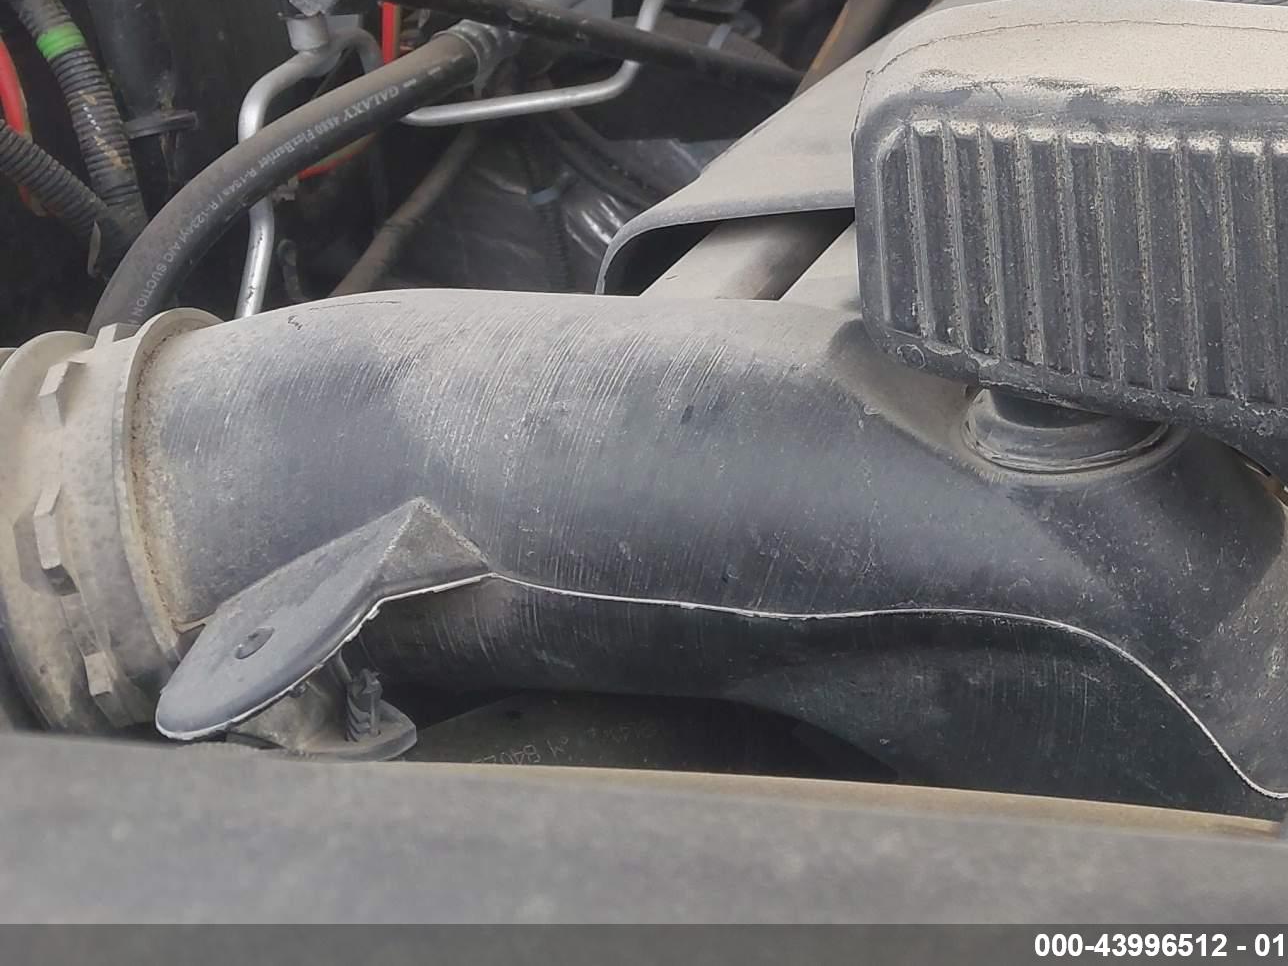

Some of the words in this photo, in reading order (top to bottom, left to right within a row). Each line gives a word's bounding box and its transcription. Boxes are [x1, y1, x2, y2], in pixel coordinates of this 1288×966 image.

[343, 85, 400, 122] GALAXY
[162, 241, 181, 263] A/C
[131, 263, 167, 318] SUCTION
